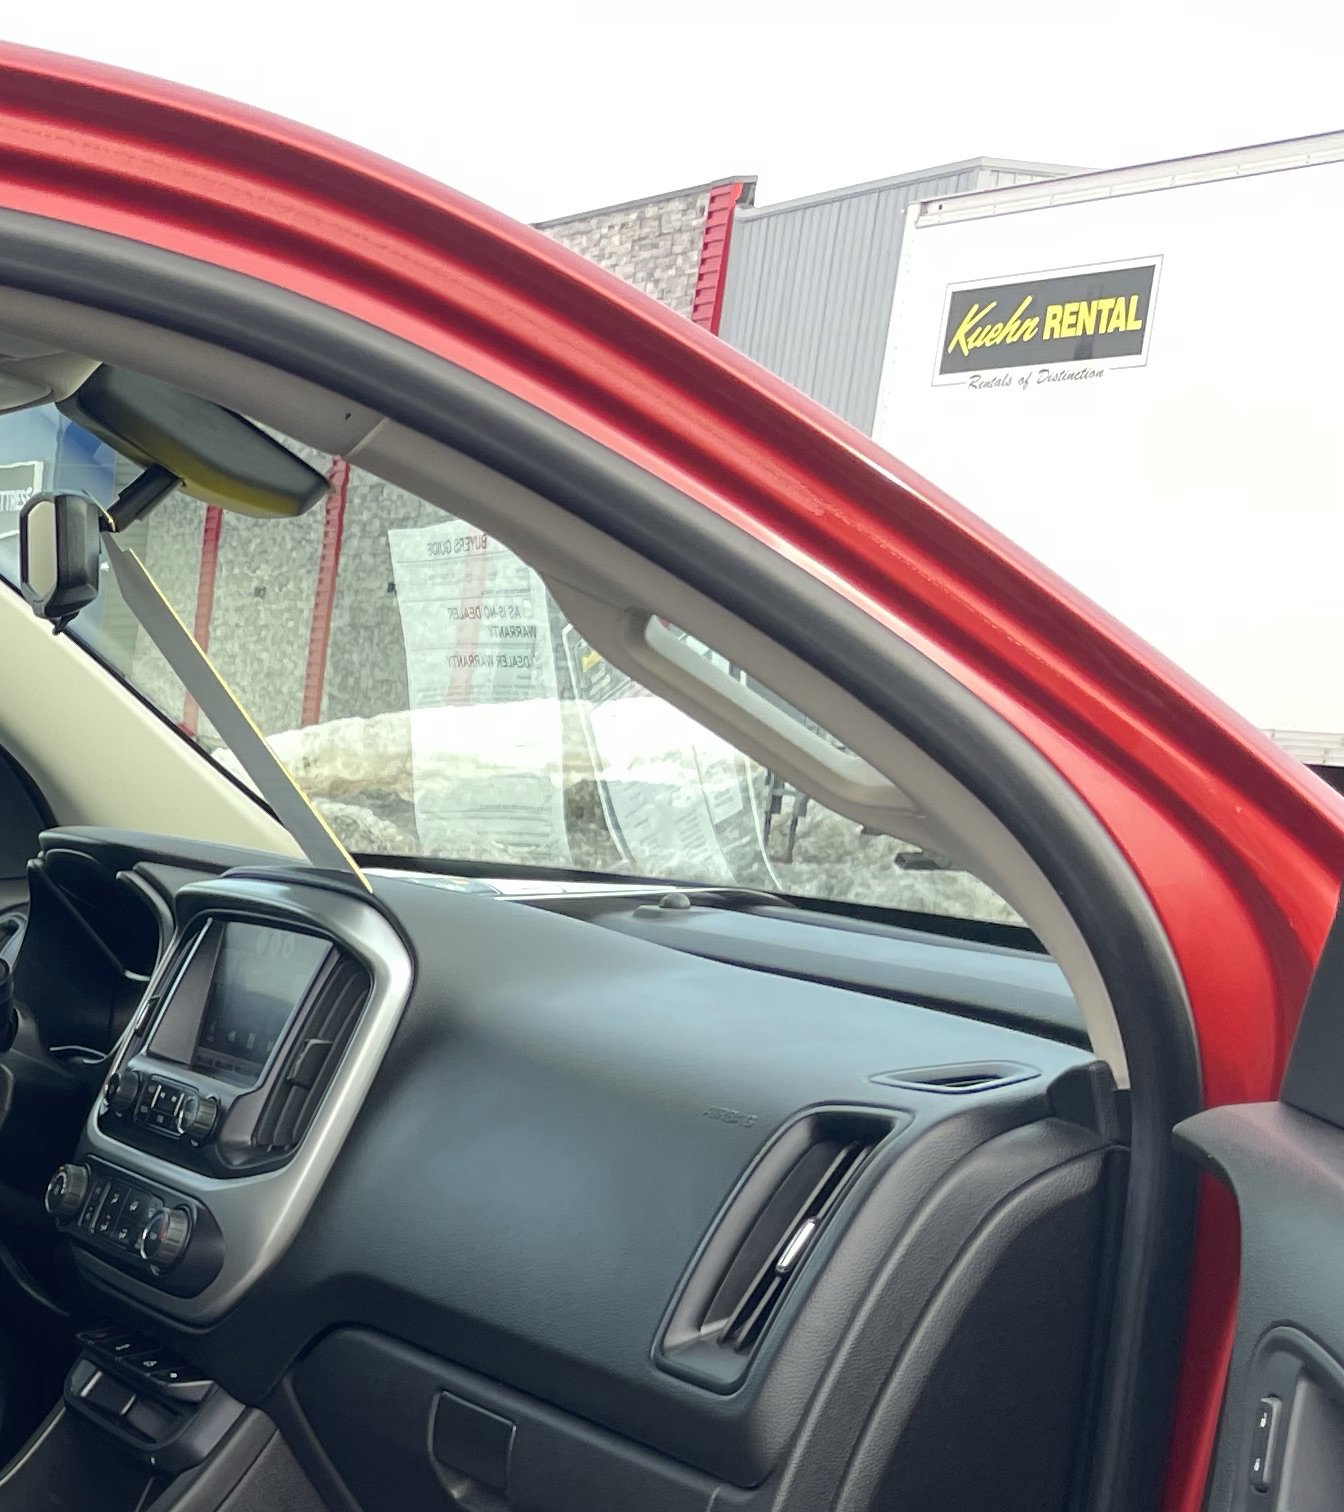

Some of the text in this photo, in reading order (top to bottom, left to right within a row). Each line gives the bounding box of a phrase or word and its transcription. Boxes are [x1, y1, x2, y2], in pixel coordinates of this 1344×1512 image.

[947, 295, 1142, 357] Kuehn RENTAL
[967, 367, 1105, 391] Rentals of Distinction
